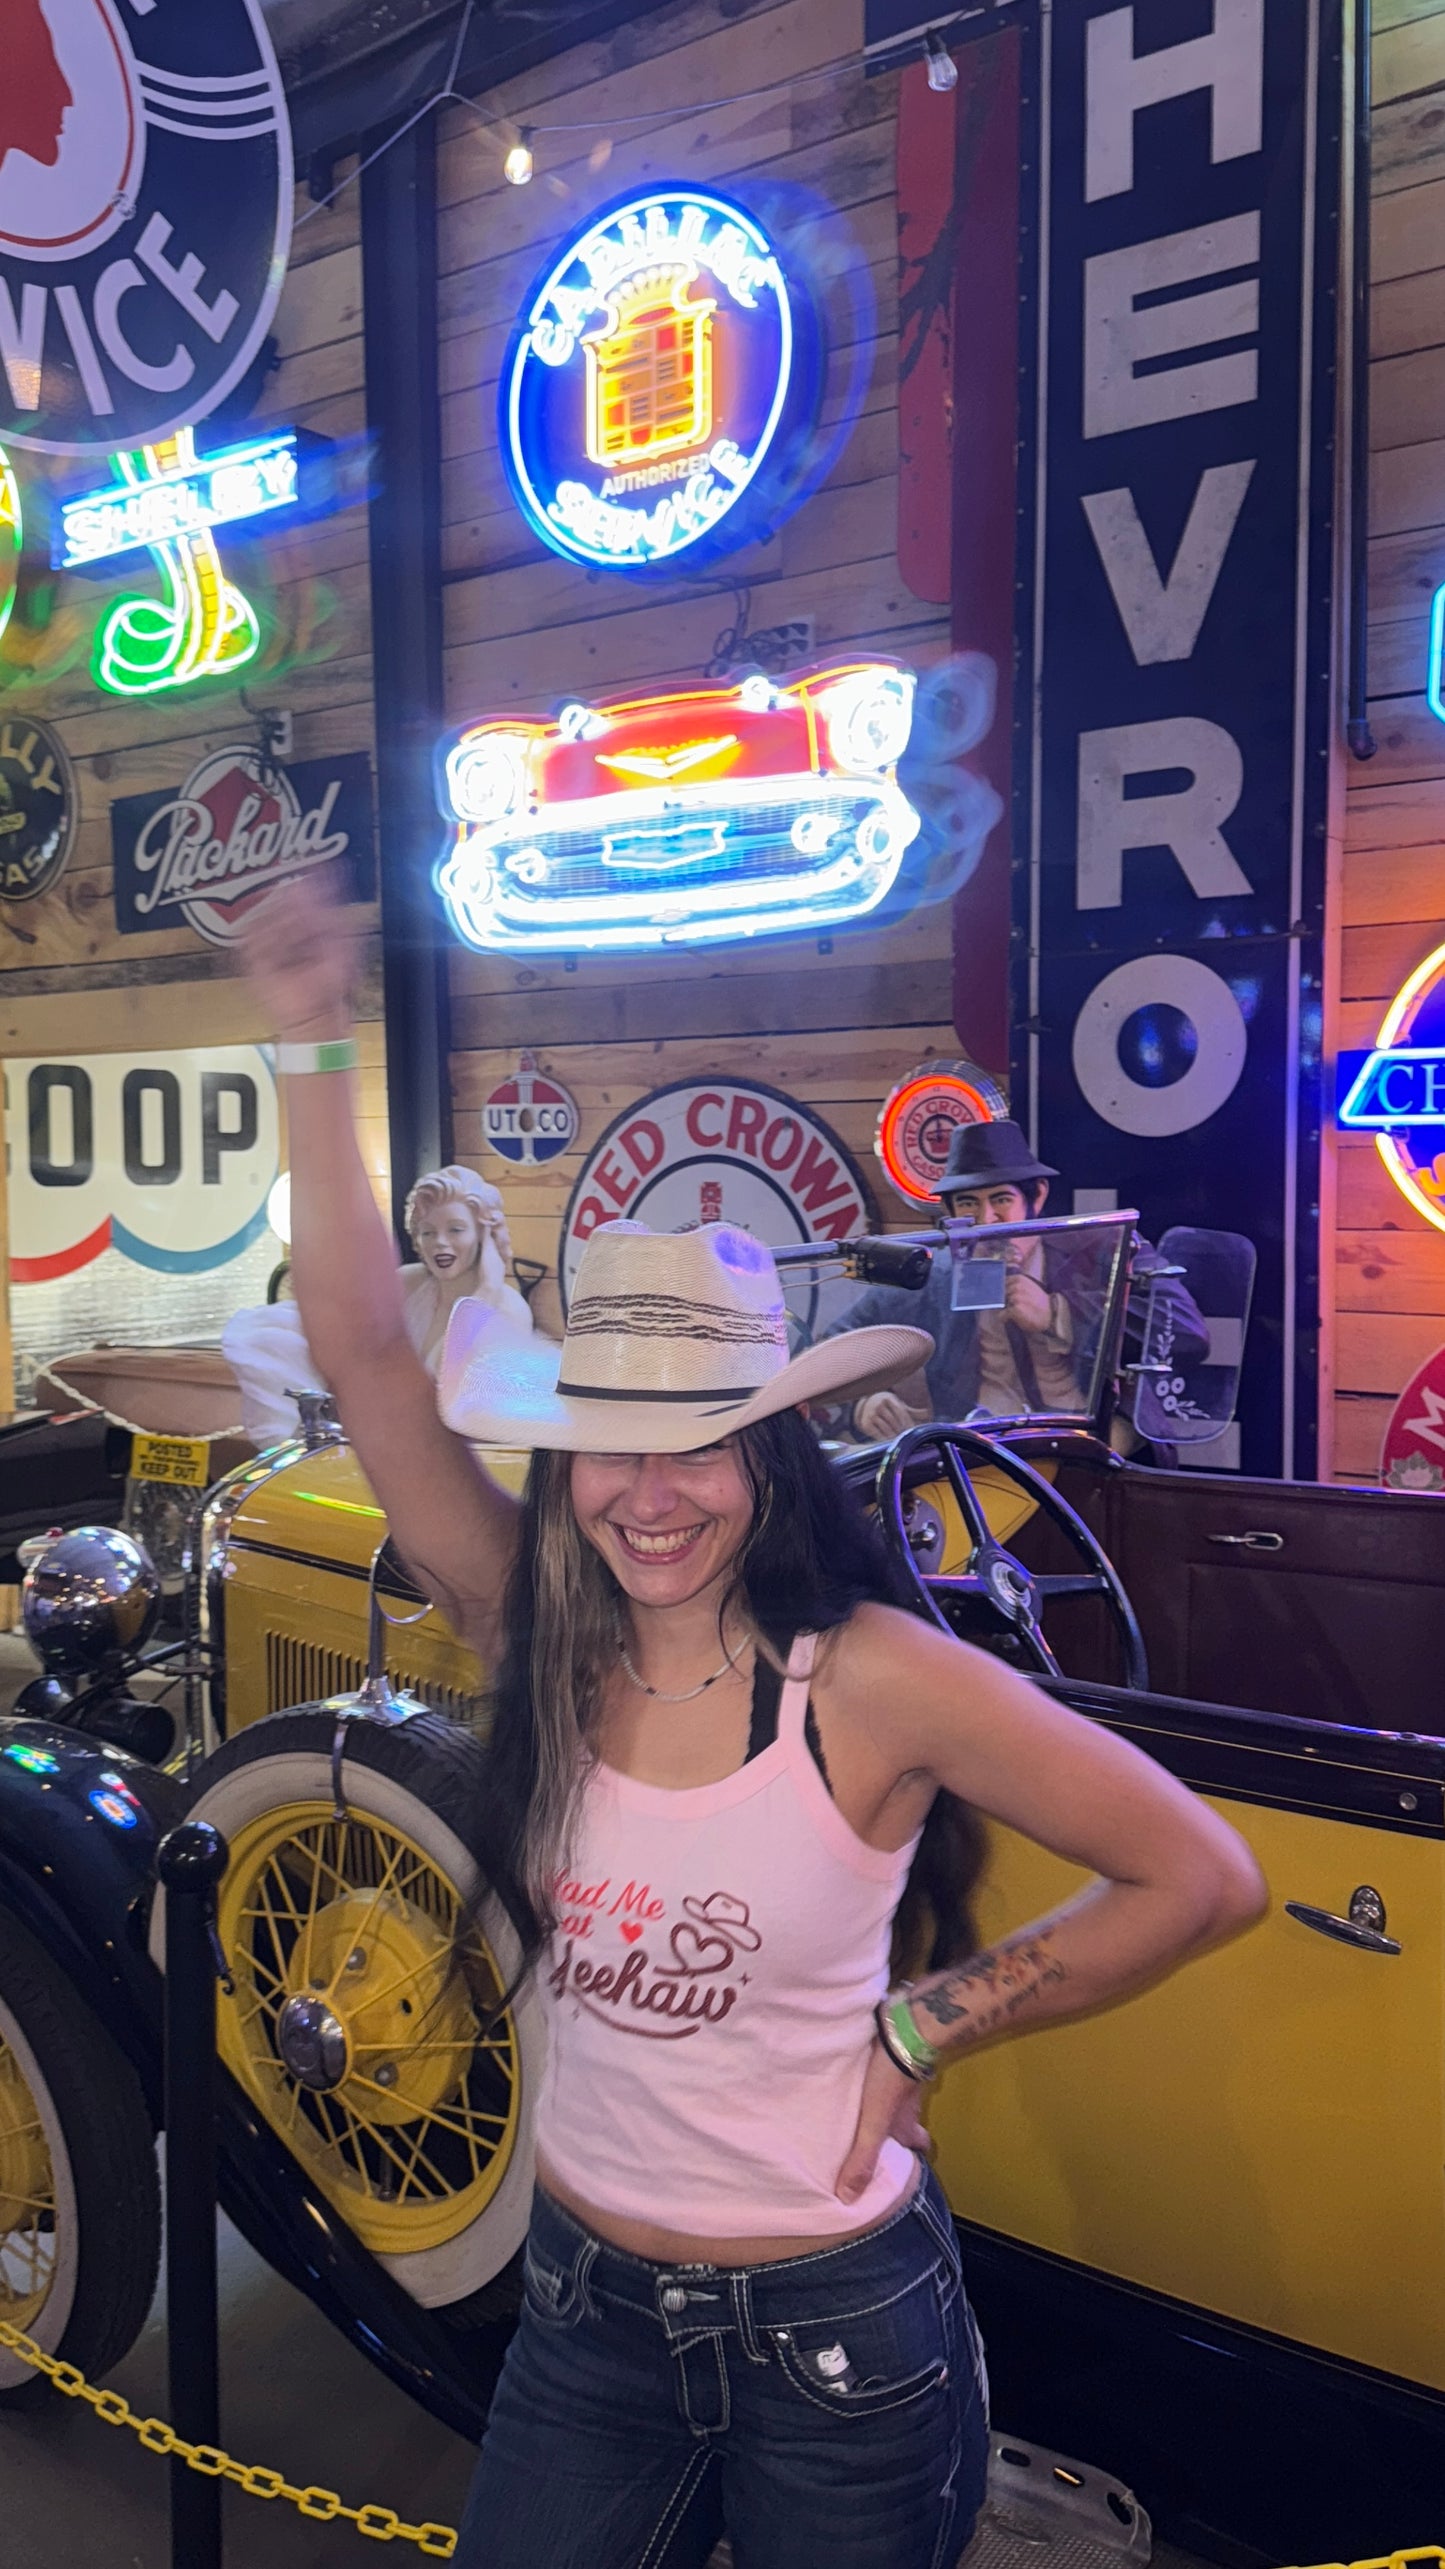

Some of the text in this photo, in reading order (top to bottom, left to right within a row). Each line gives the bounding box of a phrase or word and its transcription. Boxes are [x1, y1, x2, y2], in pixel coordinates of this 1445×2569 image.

[530, 205, 776, 367] CADILLAC
[547, 439, 753, 553] SERVICE
[600, 453, 713, 498] AUTHORIZED
[134, 782, 349, 914] Packard
[4, 1064, 258, 1187] OOP
[906, 1112, 923, 1148] RED
[572, 1119, 665, 1241] RED
[141, 1461, 198, 1480] KEEP OUT
[148, 1441, 192, 1458] POSTED
[606, 1879, 666, 1921] Me
[562, 1913, 596, 1939] at
